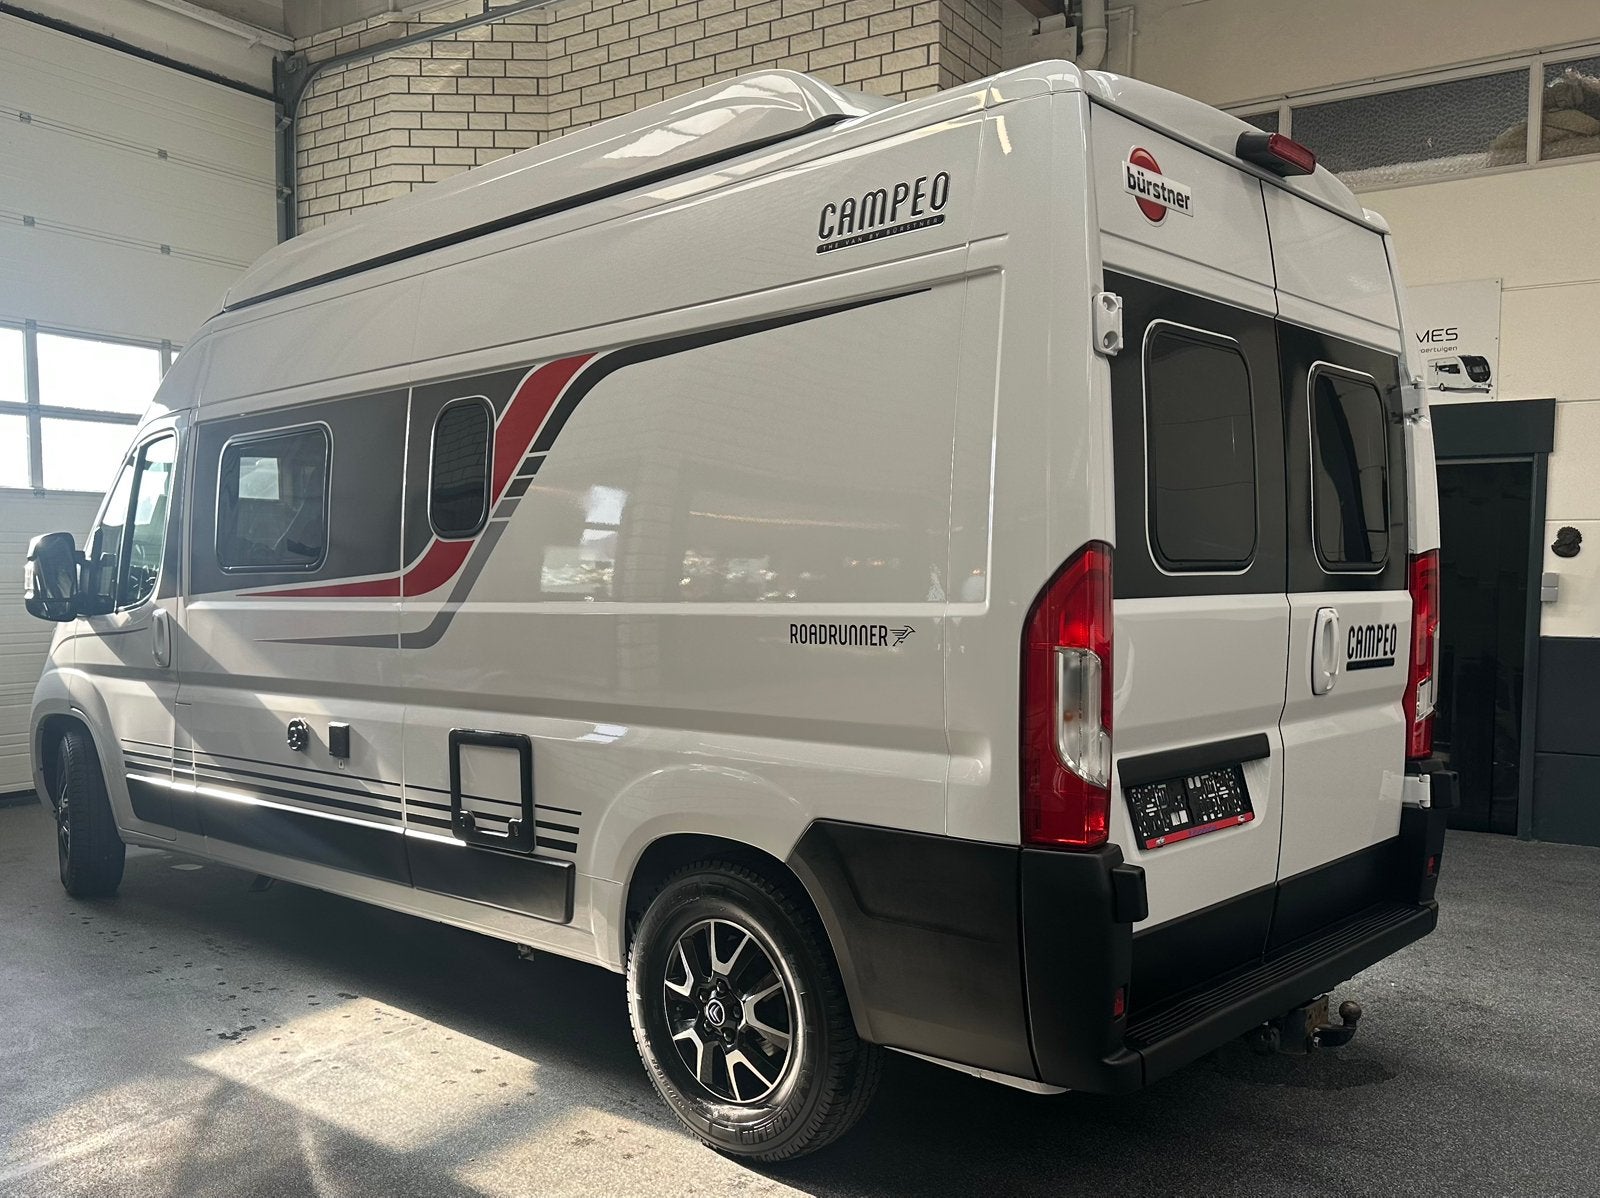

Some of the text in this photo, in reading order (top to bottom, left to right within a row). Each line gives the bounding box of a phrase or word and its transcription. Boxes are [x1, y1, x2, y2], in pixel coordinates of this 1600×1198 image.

[818, 171, 950, 240] CAMPEO
[1126, 165, 1190, 210] bürstner
[823, 243, 839, 251] THE
[845, 237, 863, 246] VAN
[869, 232, 880, 240] BY
[789, 623, 888, 647] ROADRUNNER
[1346, 623, 1397, 660] CAMPEO
